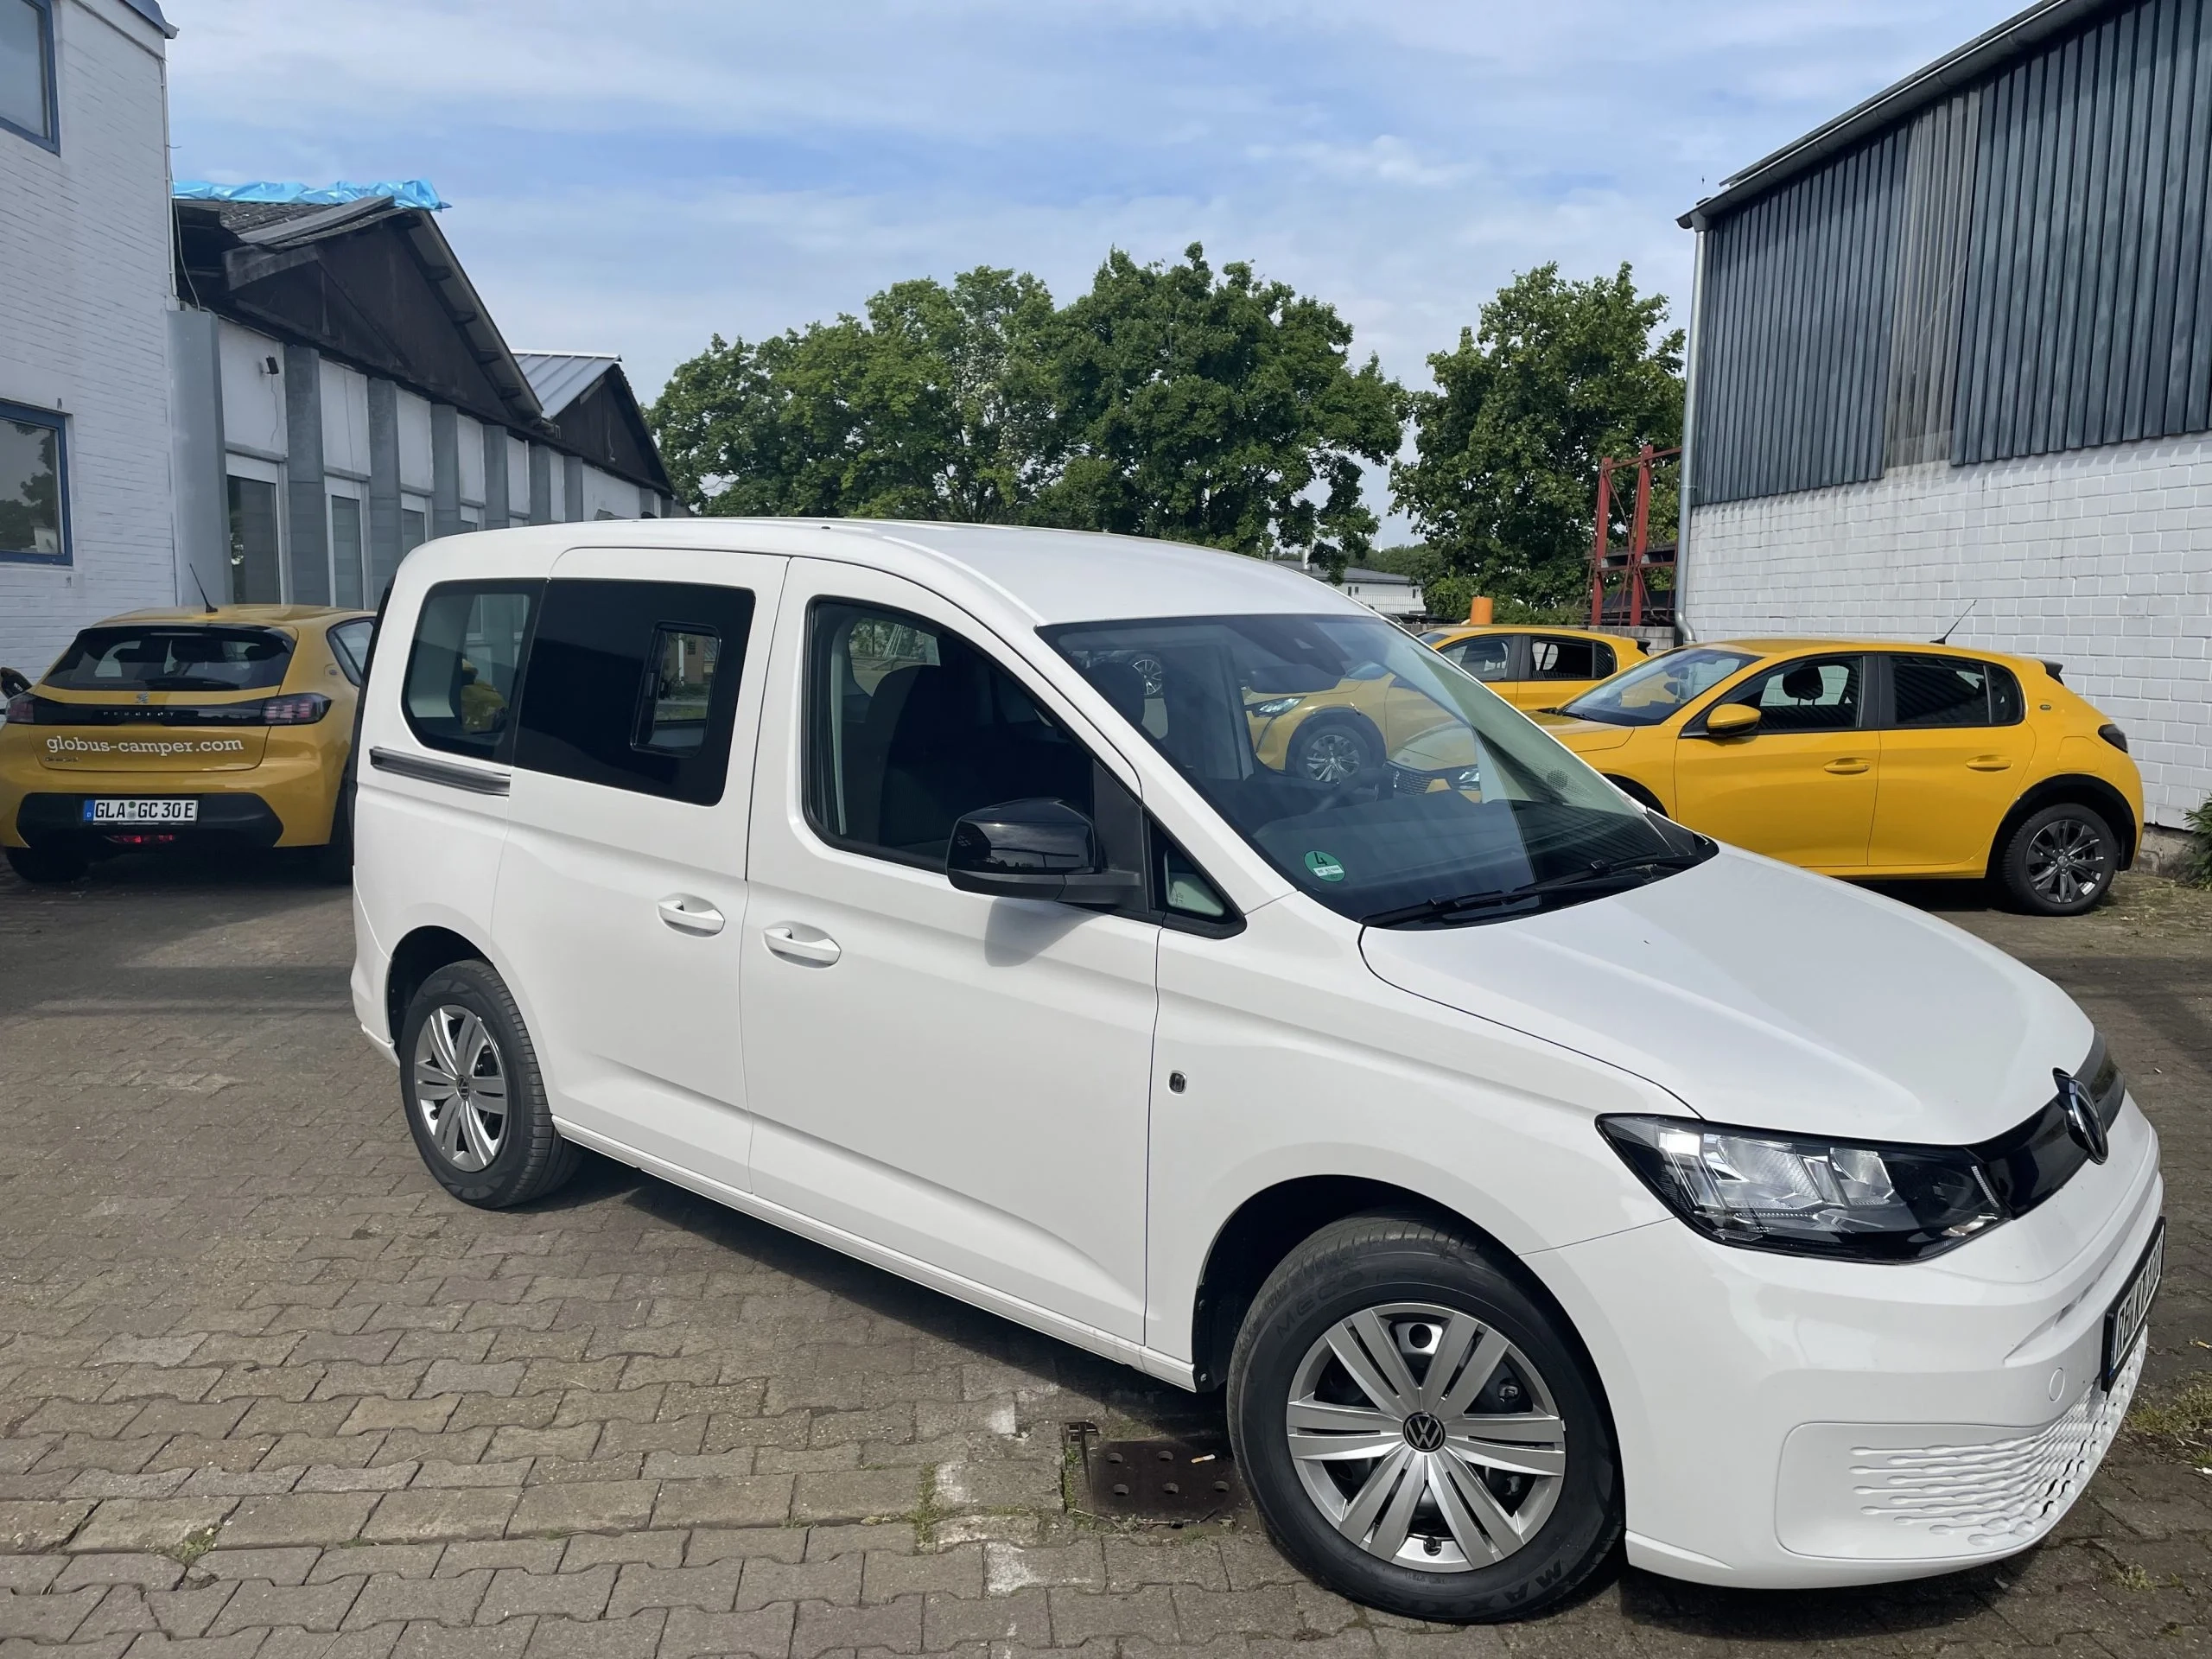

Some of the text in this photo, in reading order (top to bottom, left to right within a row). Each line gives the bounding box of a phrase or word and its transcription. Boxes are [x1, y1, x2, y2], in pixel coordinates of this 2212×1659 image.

[46, 736, 245, 756] globus-camper.com
[95, 802, 125, 818] GLA
[137, 802, 158, 818] GC
[1313, 851, 1328, 865] 4
